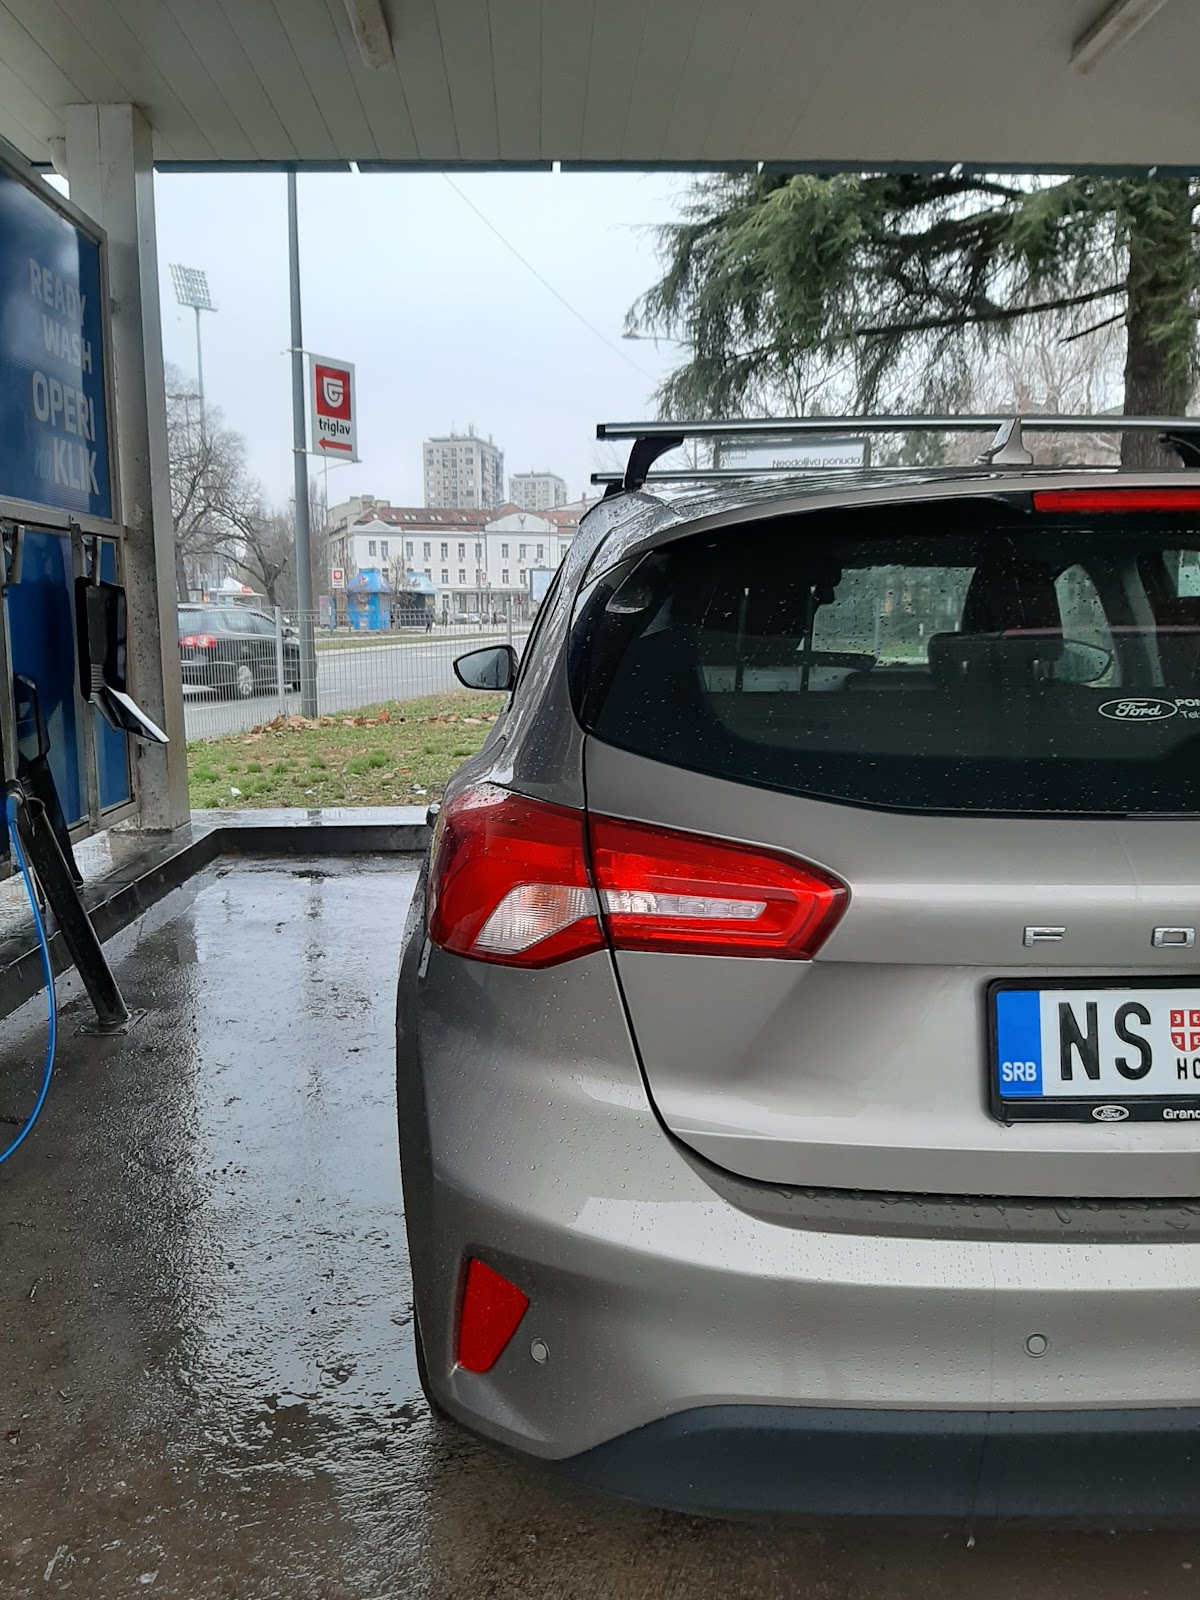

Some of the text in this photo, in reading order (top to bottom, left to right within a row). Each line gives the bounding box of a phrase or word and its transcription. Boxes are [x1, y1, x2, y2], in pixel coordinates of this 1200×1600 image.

[29, 258, 86, 326] READY
[42, 316, 93, 374] WASH
[32, 370, 96, 442] OPERI
[319, 418, 351, 436] triglav
[52, 436, 100, 495] KLIK
[822, 456, 861, 468] ponuda
[1115, 701, 1162, 717] Ford
[1058, 1001, 1153, 1081] NS
[1002, 1061, 1038, 1082] SRB
